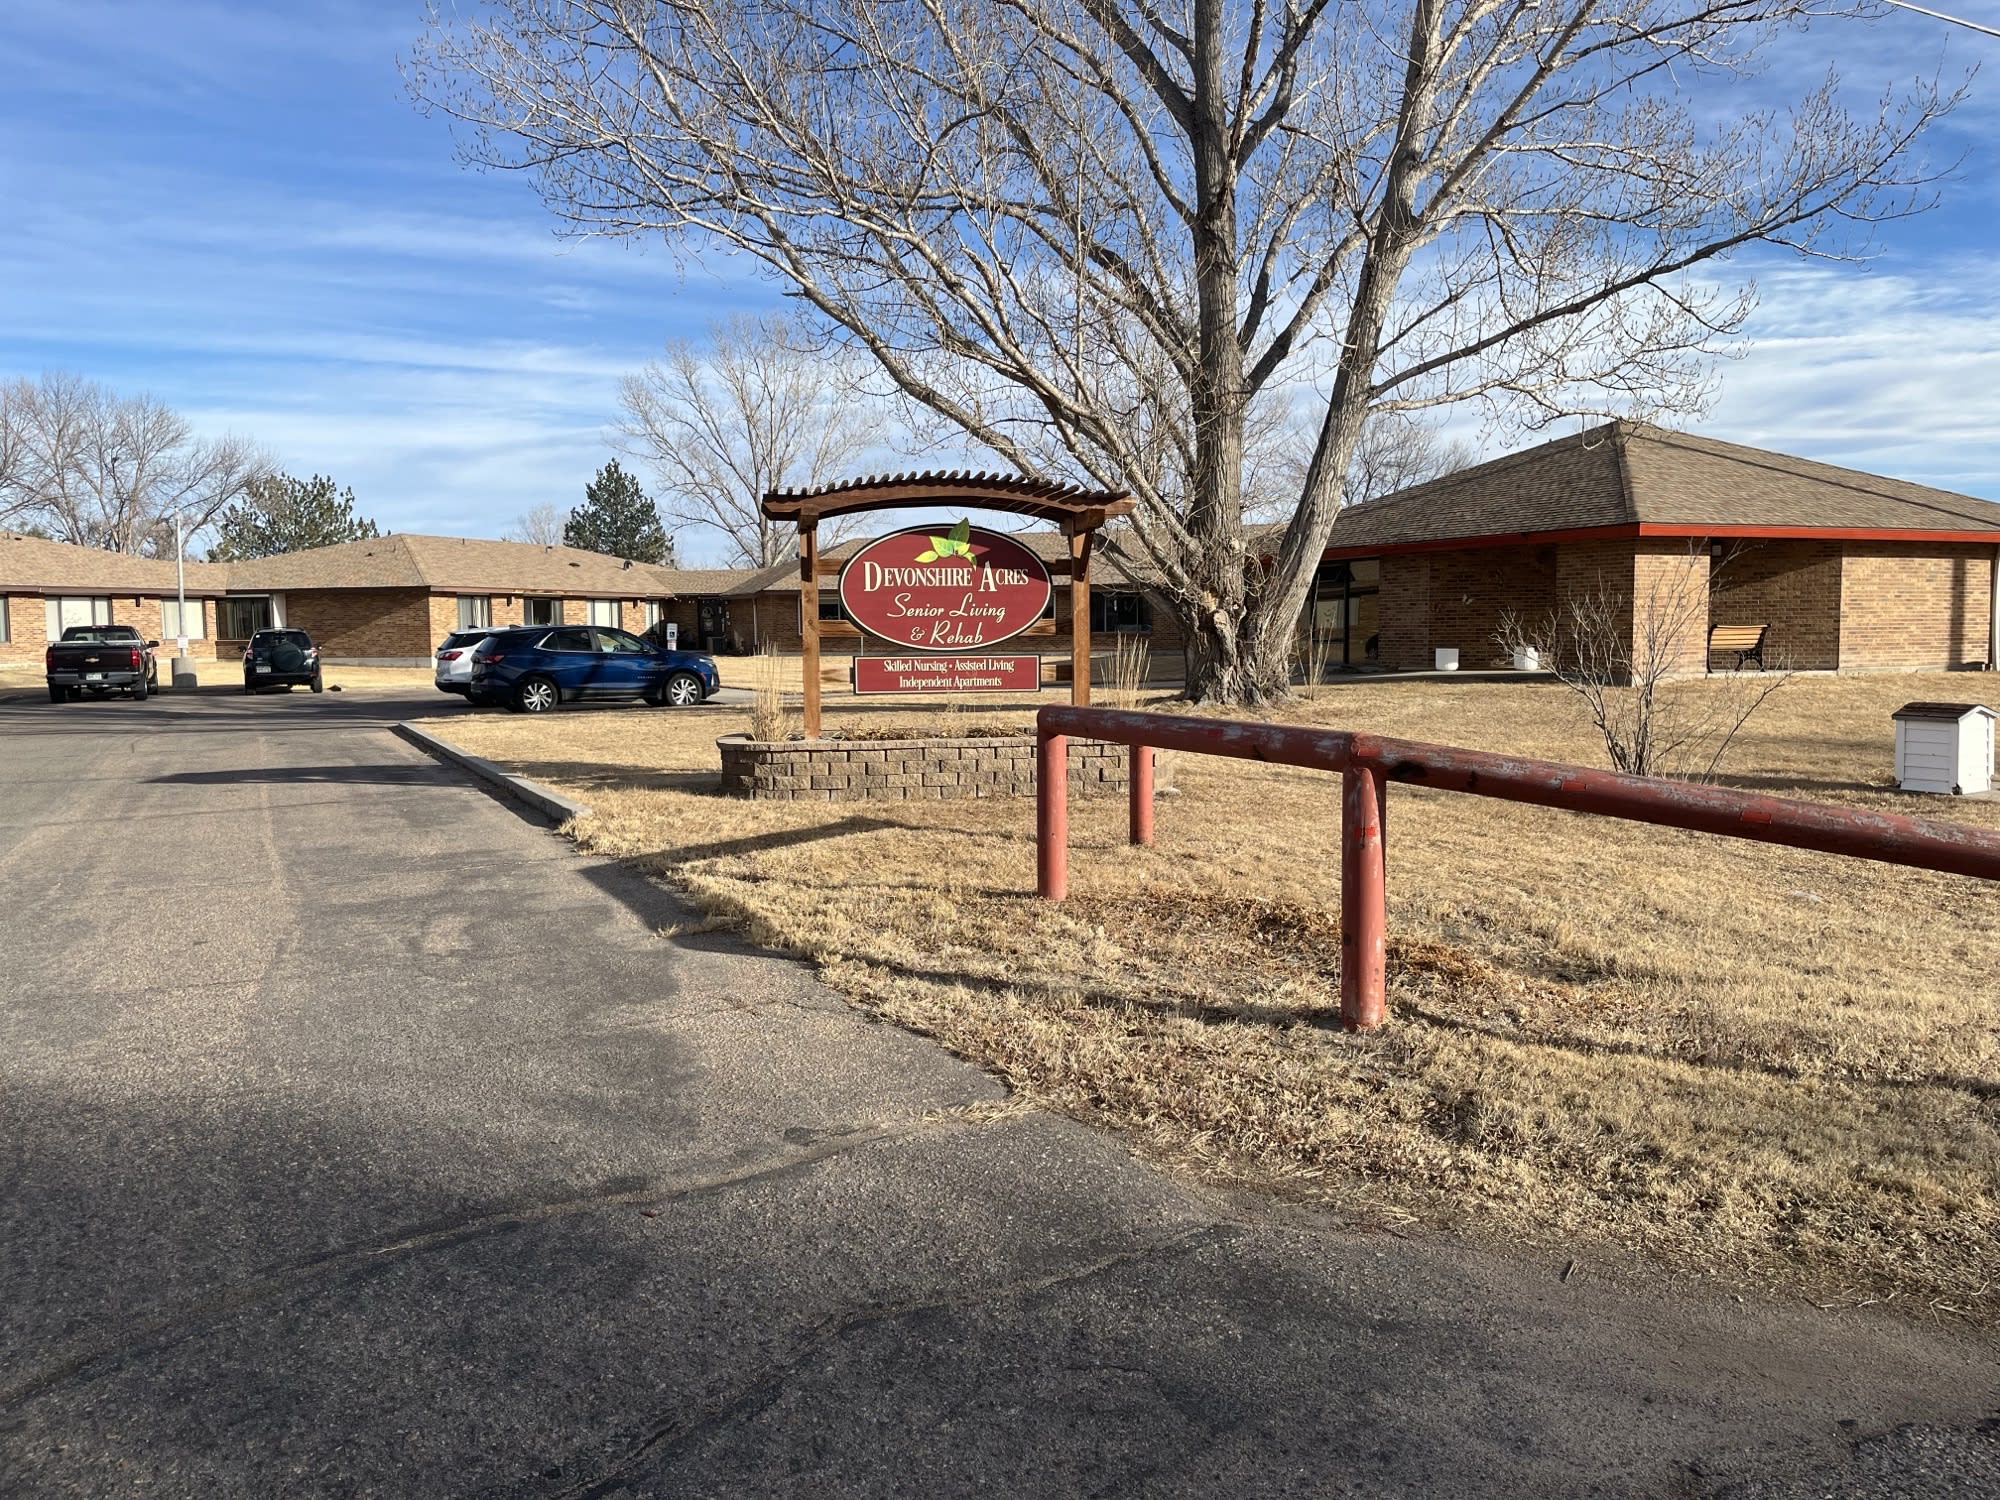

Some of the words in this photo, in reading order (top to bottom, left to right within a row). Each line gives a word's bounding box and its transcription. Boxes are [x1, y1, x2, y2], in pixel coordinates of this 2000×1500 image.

[864, 561, 973, 592] DEVONSHIRE
[978, 560, 1029, 592] ACRES
[887, 593, 944, 617] Senior
[949, 592, 1006, 623] Living
[910, 627, 925, 641] &
[929, 620, 983, 644] Rehab
[884, 660, 912, 672] Skilled
[914, 660, 947, 673] Nursing
[954, 659, 986, 671] Assisted
[988, 659, 1015, 673] Living
[899, 676, 952, 691] Independent
[953, 675, 1002, 690] Apartments
